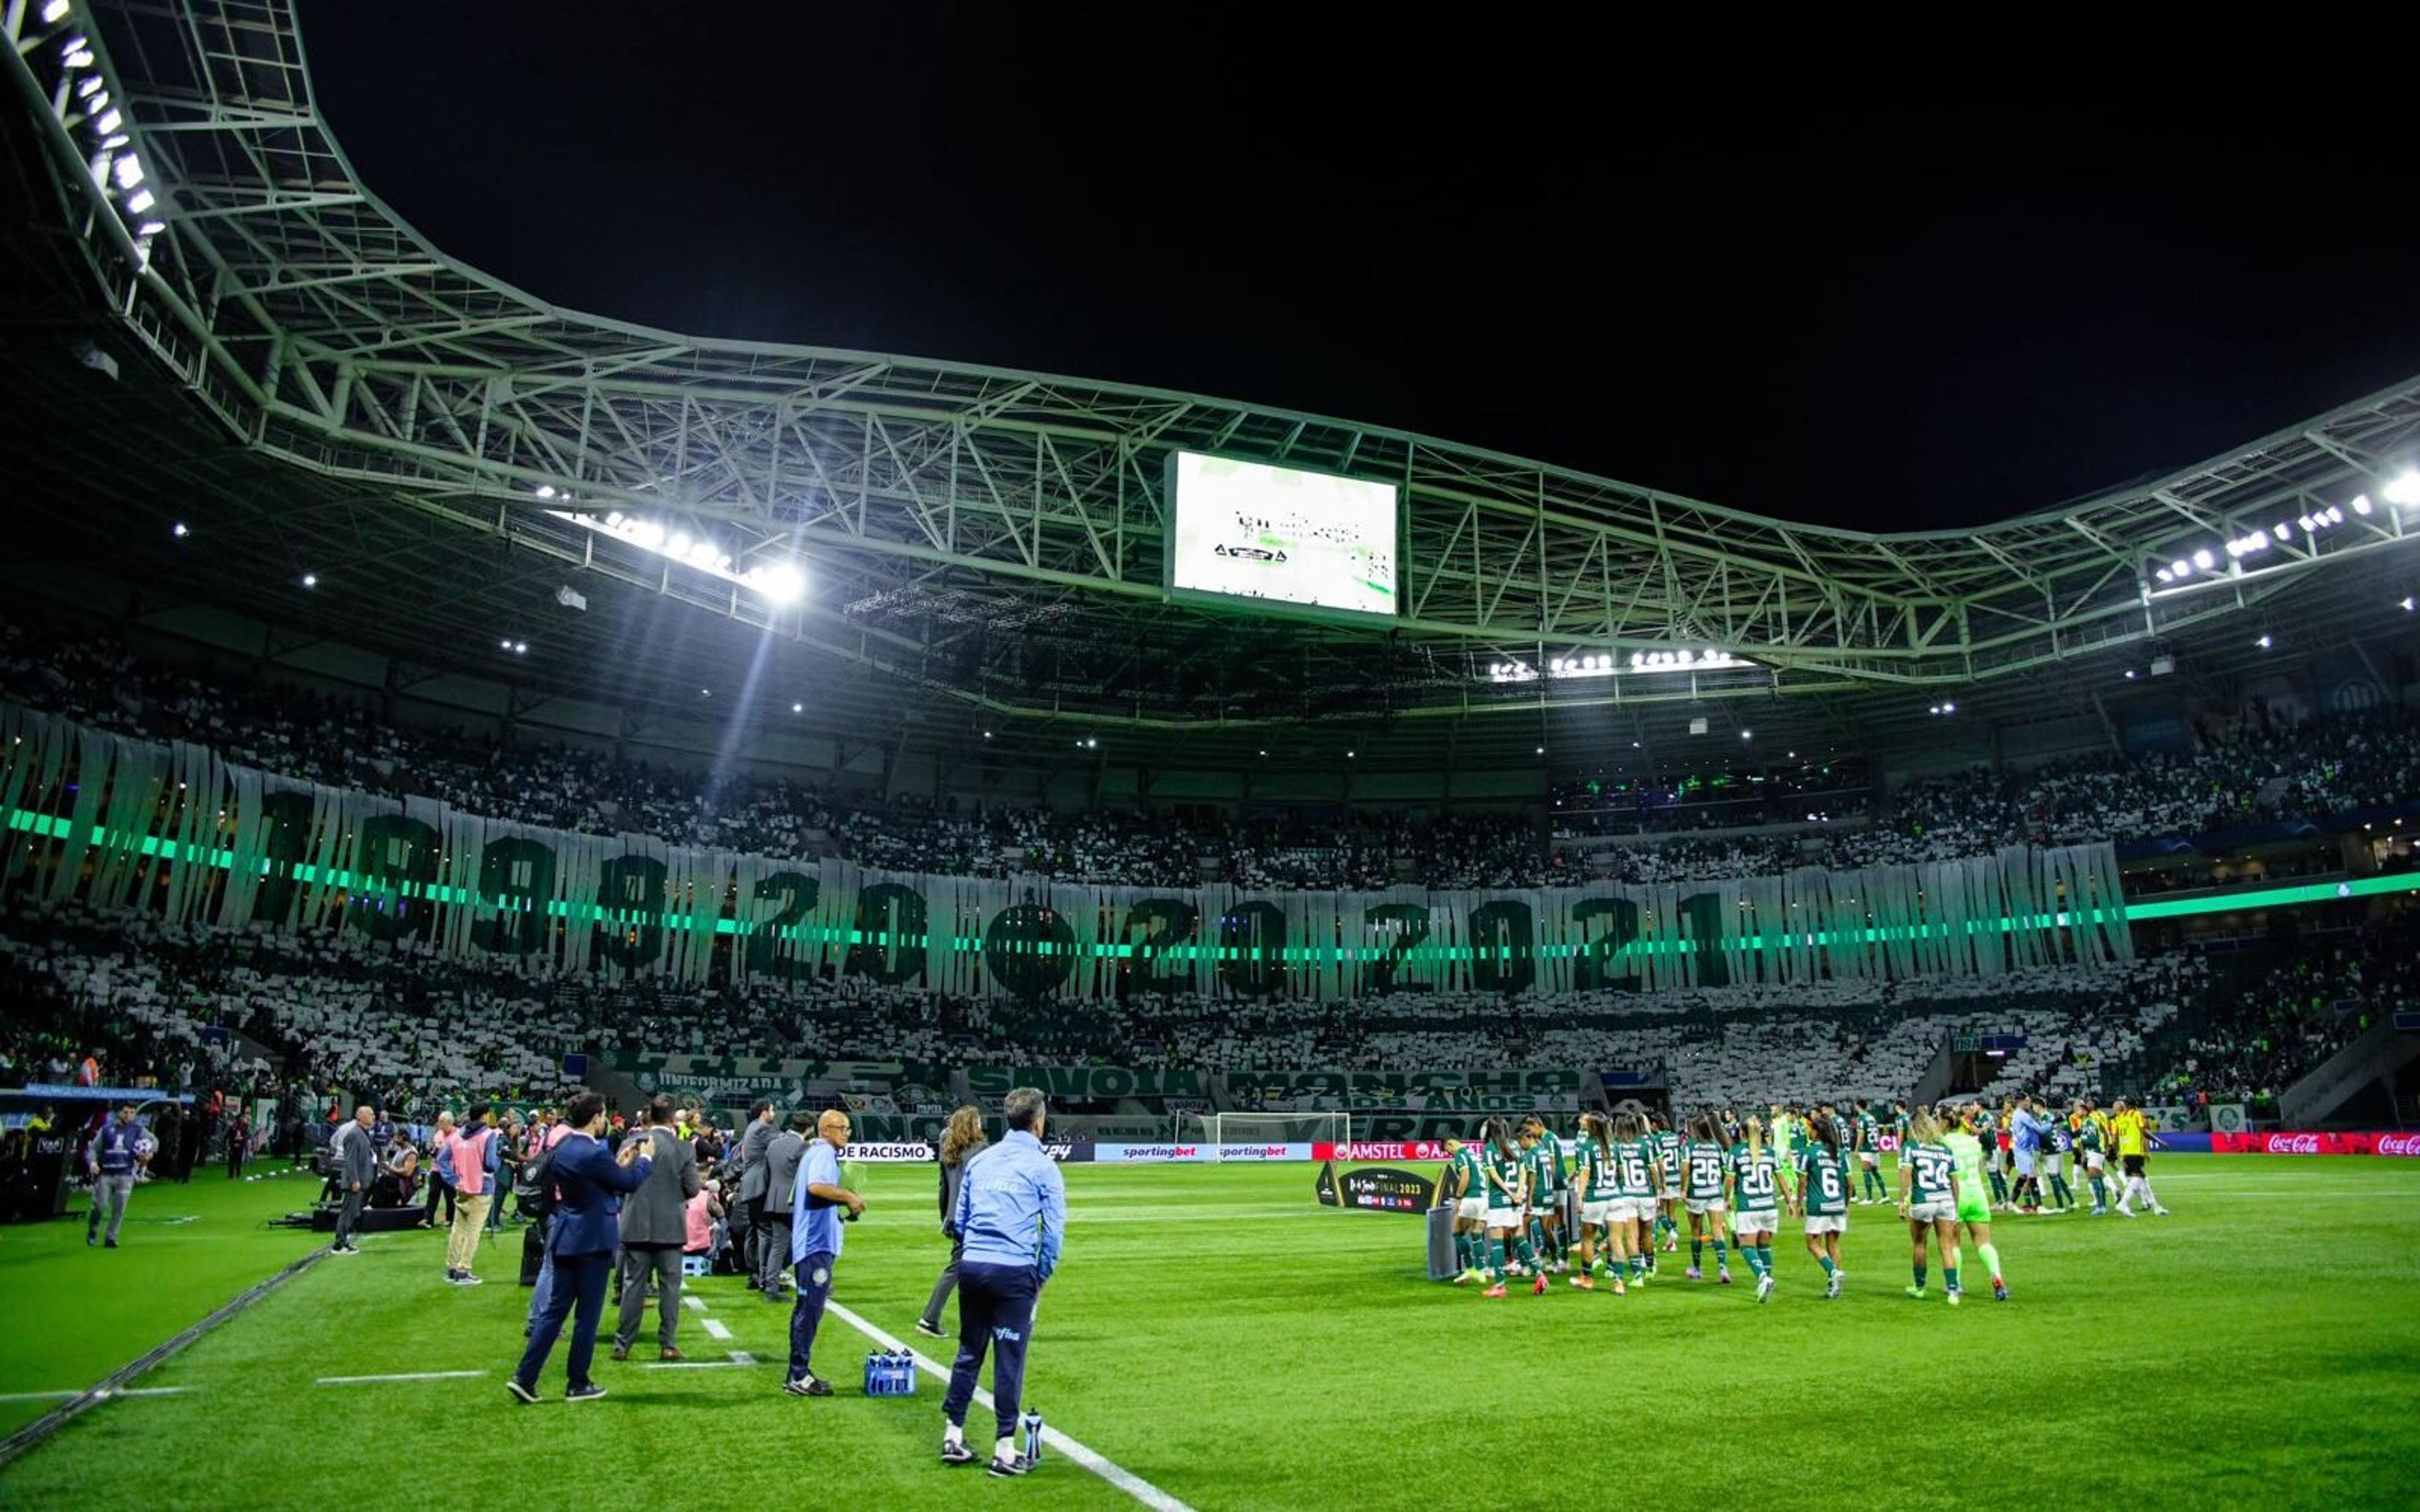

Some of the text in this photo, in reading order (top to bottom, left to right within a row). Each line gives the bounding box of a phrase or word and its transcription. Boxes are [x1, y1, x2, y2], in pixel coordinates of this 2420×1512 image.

[968, 1066, 1201, 1095] SAVOIA
[836, 1147, 926, 1158] DE RACISMO
[1124, 1146, 1196, 1159] sportingbet
[1351, 1145, 1403, 1158] AMSTEL
[1664, 1148, 1680, 1171] 21
[1596, 1160, 1616, 1188] 19
[1623, 1159, 1647, 1187] 16
[1692, 1158, 1720, 1186] 26
[1741, 1164, 1774, 1195] 20
[1821, 1167, 1840, 1198] 6
[1916, 1158, 1952, 1190] 24
